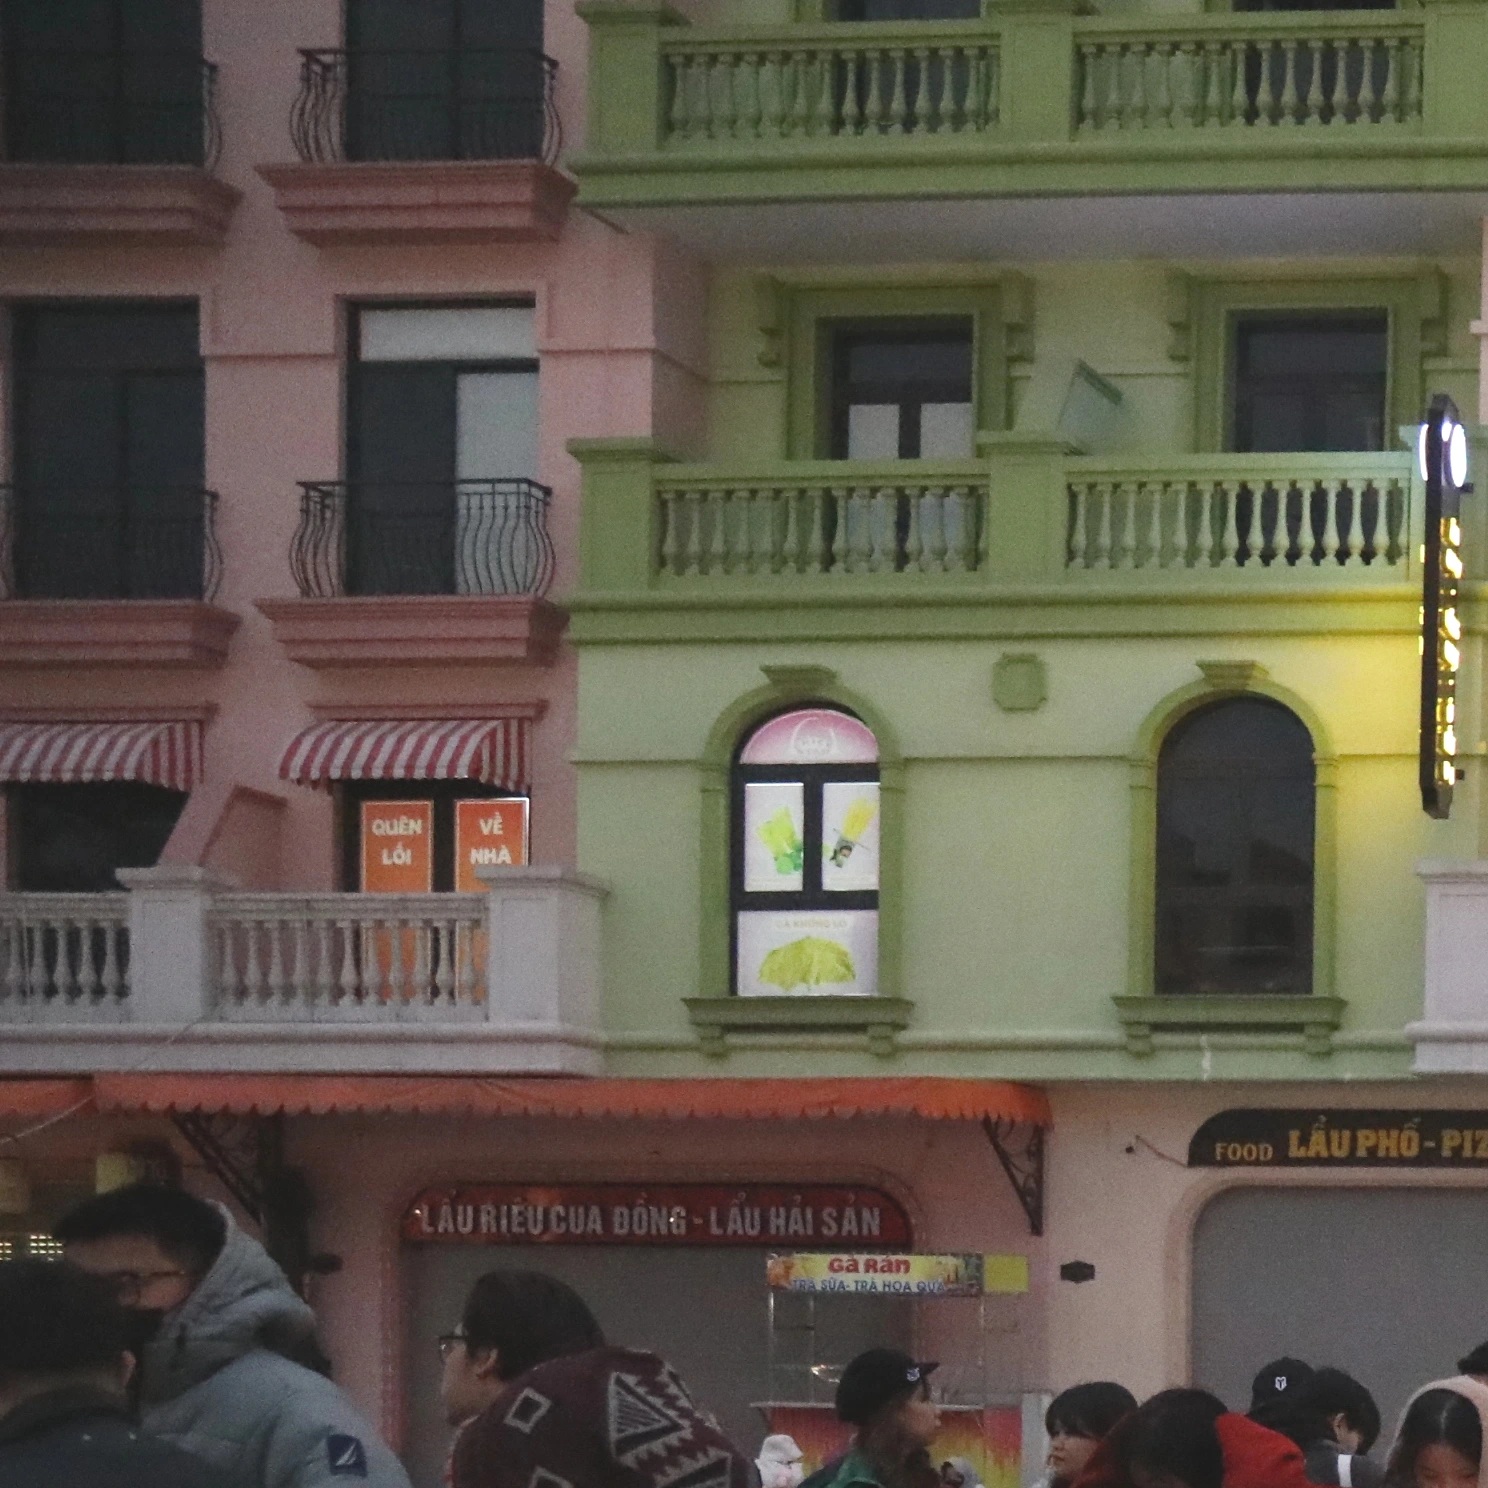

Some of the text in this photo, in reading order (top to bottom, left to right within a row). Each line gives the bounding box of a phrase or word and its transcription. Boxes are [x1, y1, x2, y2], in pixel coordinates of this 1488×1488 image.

[372, 815, 423, 836] QUÊN
[479, 812, 503, 835] VỀ
[470, 845, 512, 865] NHÀ
[1215, 1142, 1274, 1161] FOOD
[1289, 1115, 1350, 1158] LẨU
[551, 1205, 603, 1235] CUA
[710, 1192, 761, 1236] LẨU
[769, 1195, 814, 1236] HẢI
[822, 1195, 881, 1236] SẢN
[854, 1277, 878, 1292] TRÀ
[883, 1280, 912, 1292] HOA
